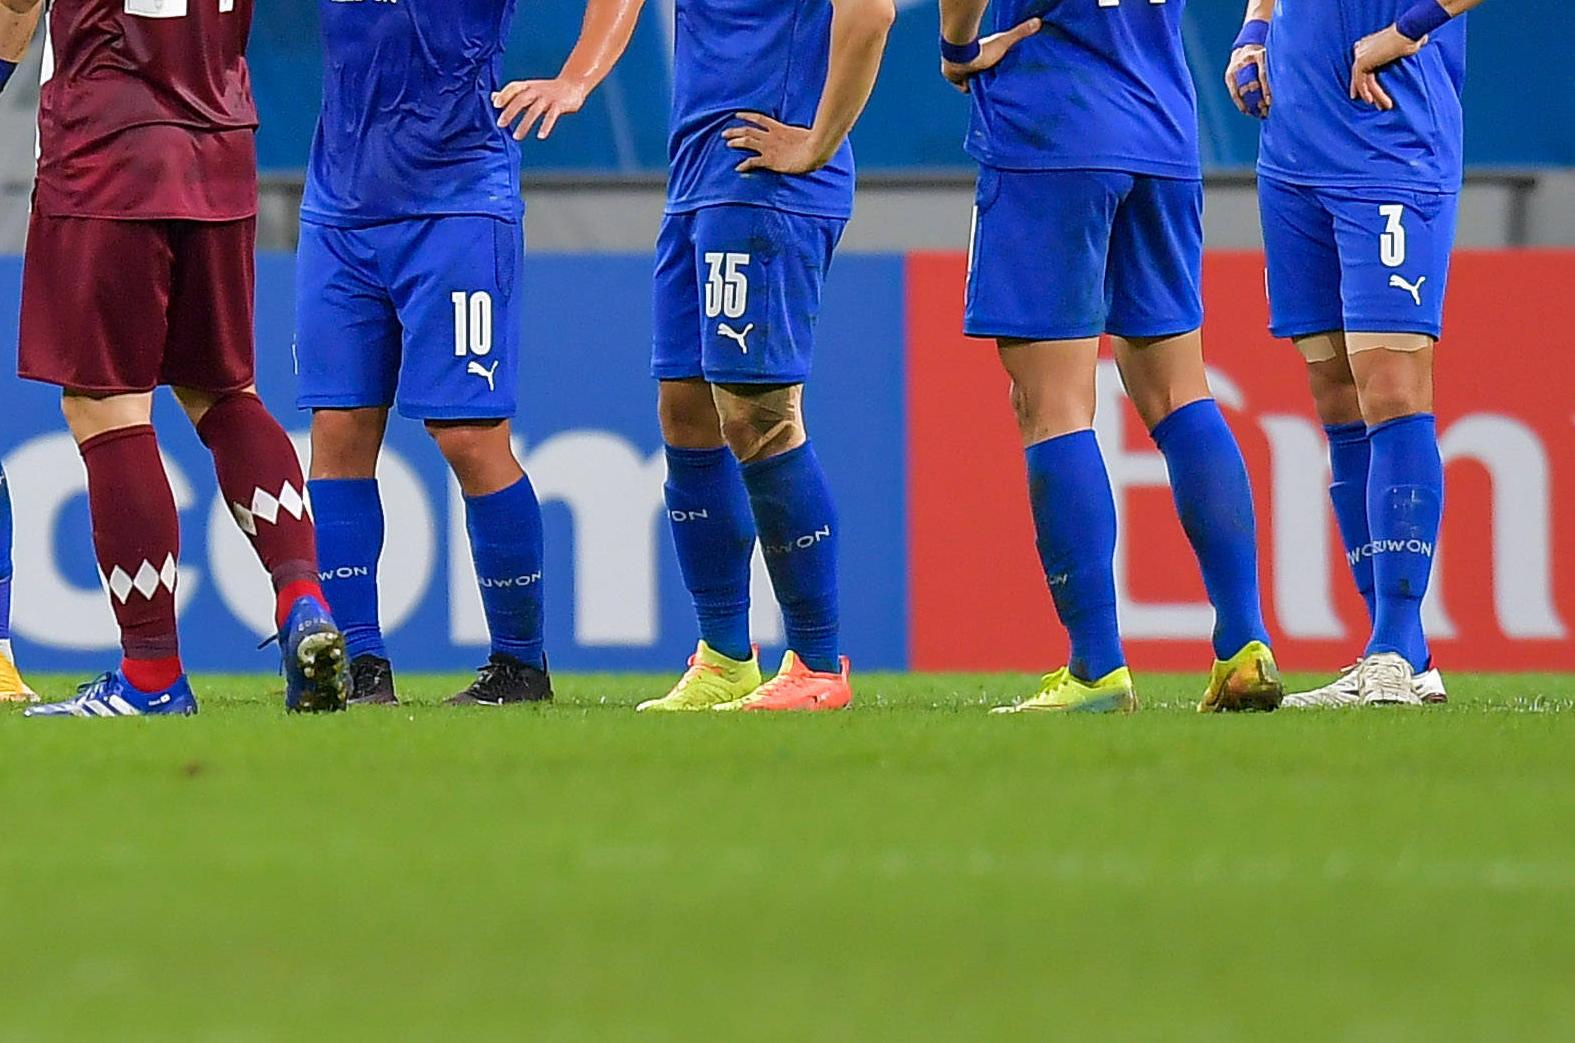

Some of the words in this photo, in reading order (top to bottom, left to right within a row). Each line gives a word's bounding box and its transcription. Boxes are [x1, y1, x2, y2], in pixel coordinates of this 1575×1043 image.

[1378, 204, 1405, 267] 3
[704, 252, 750, 318] 35
[451, 290, 492, 356] 10
[1372, 539, 1432, 558] SUWON
